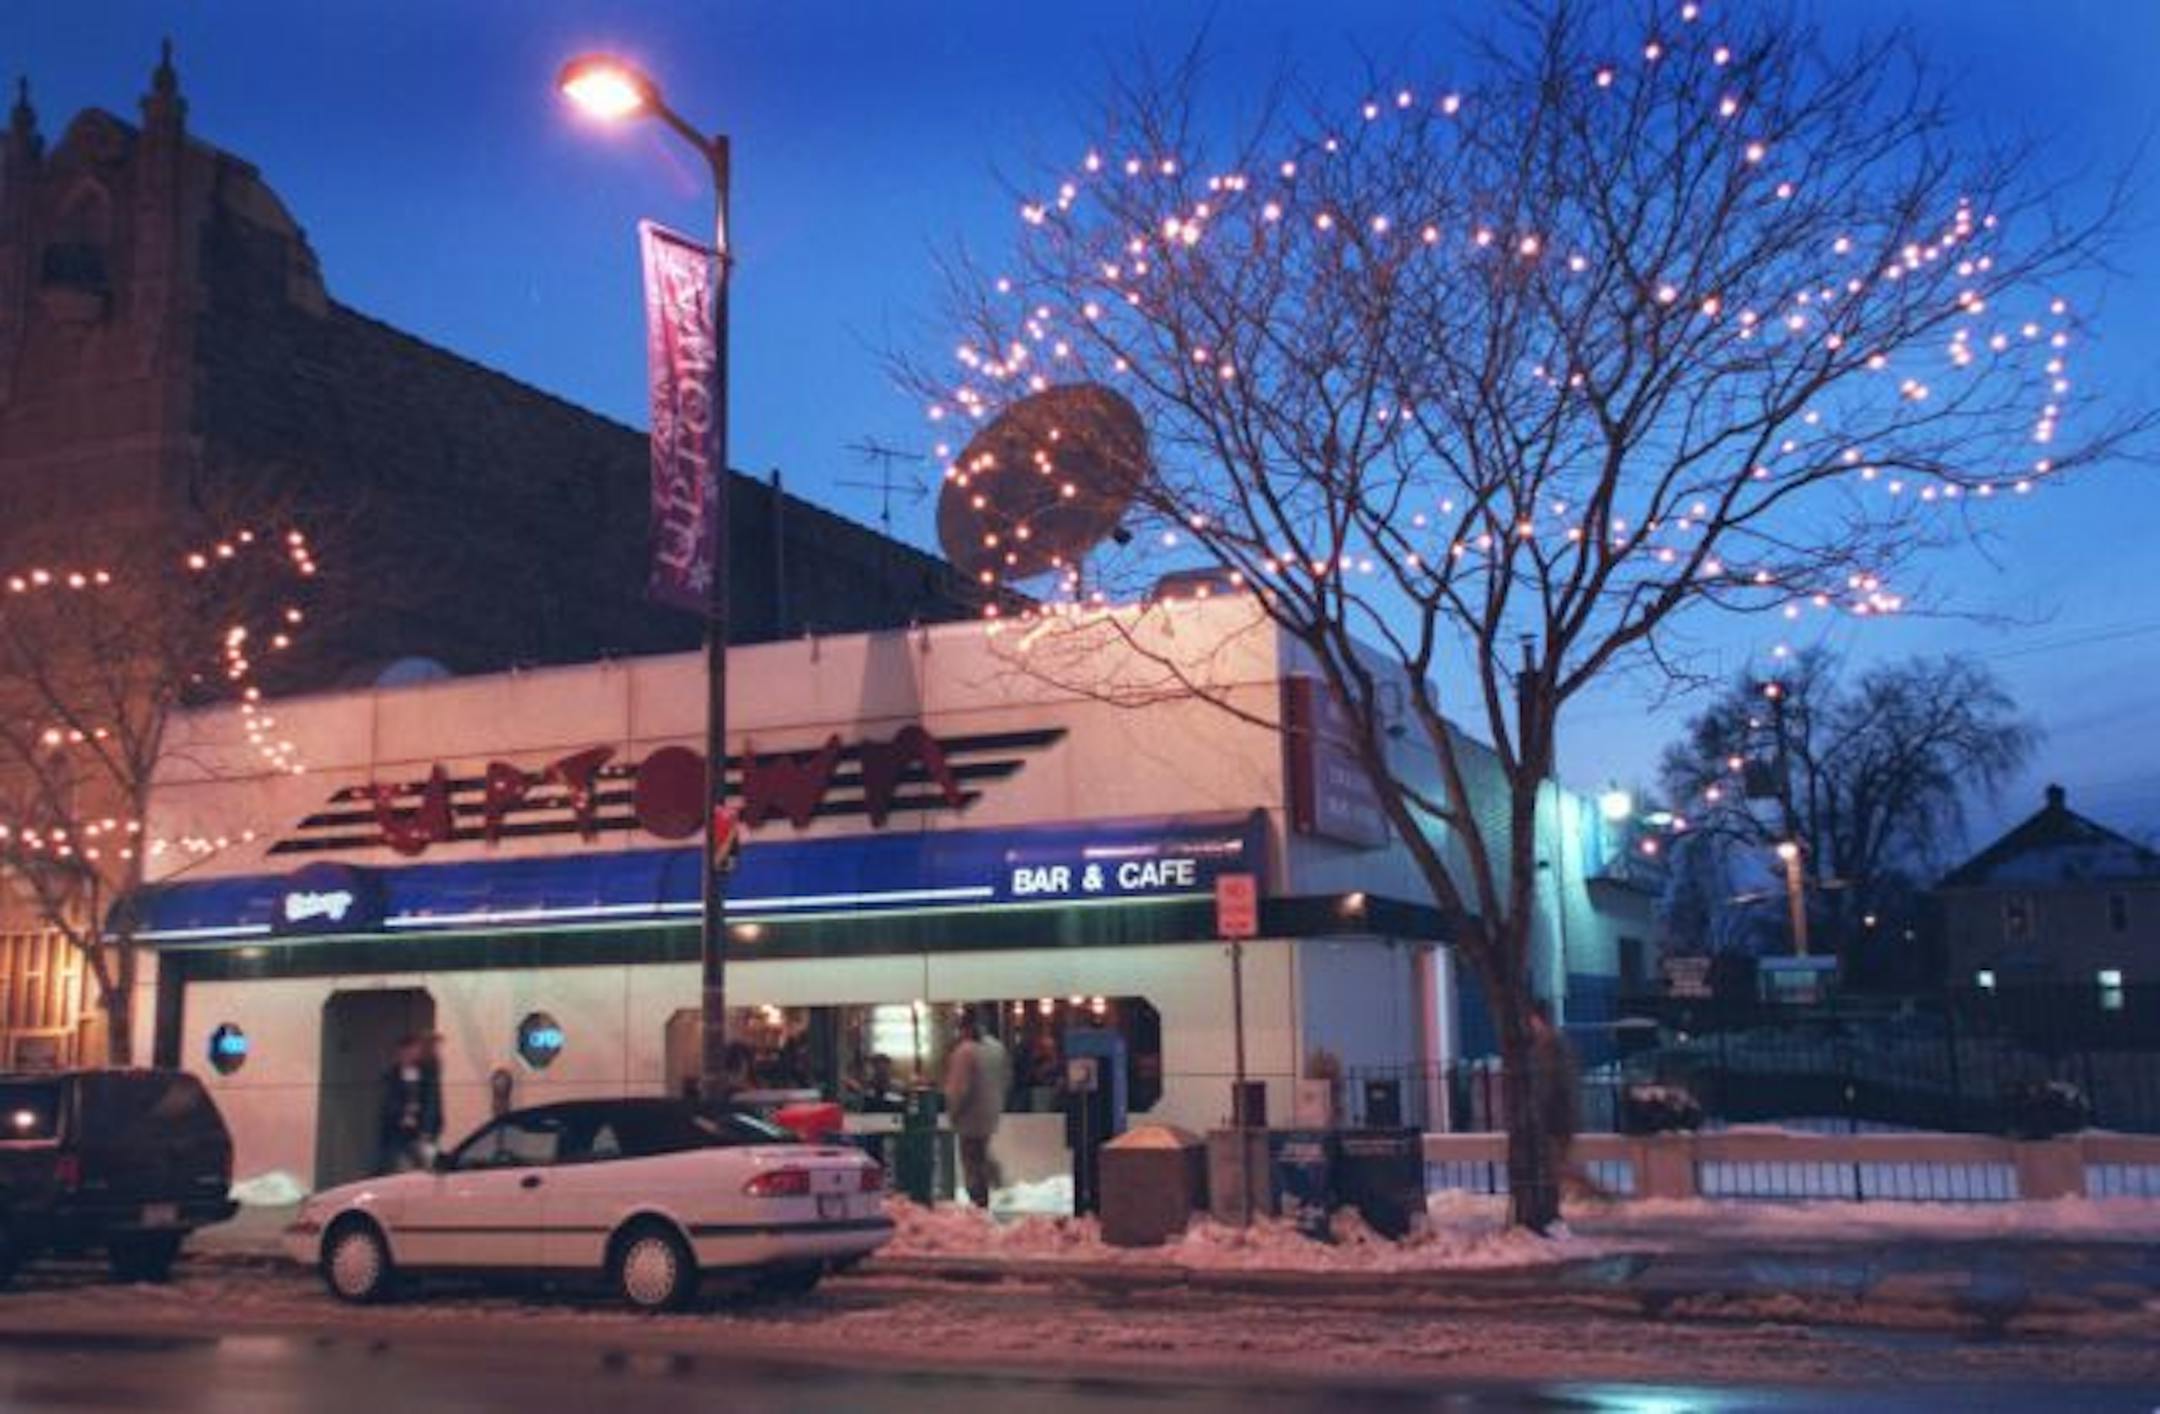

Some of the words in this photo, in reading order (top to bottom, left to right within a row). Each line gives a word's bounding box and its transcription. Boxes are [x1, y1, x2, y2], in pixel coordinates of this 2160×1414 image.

[371, 723, 968, 858] UPTOWN
[1012, 865, 1071, 895] BAR
[1082, 863, 1104, 892] &
[1118, 858, 1197, 890] CAFE
